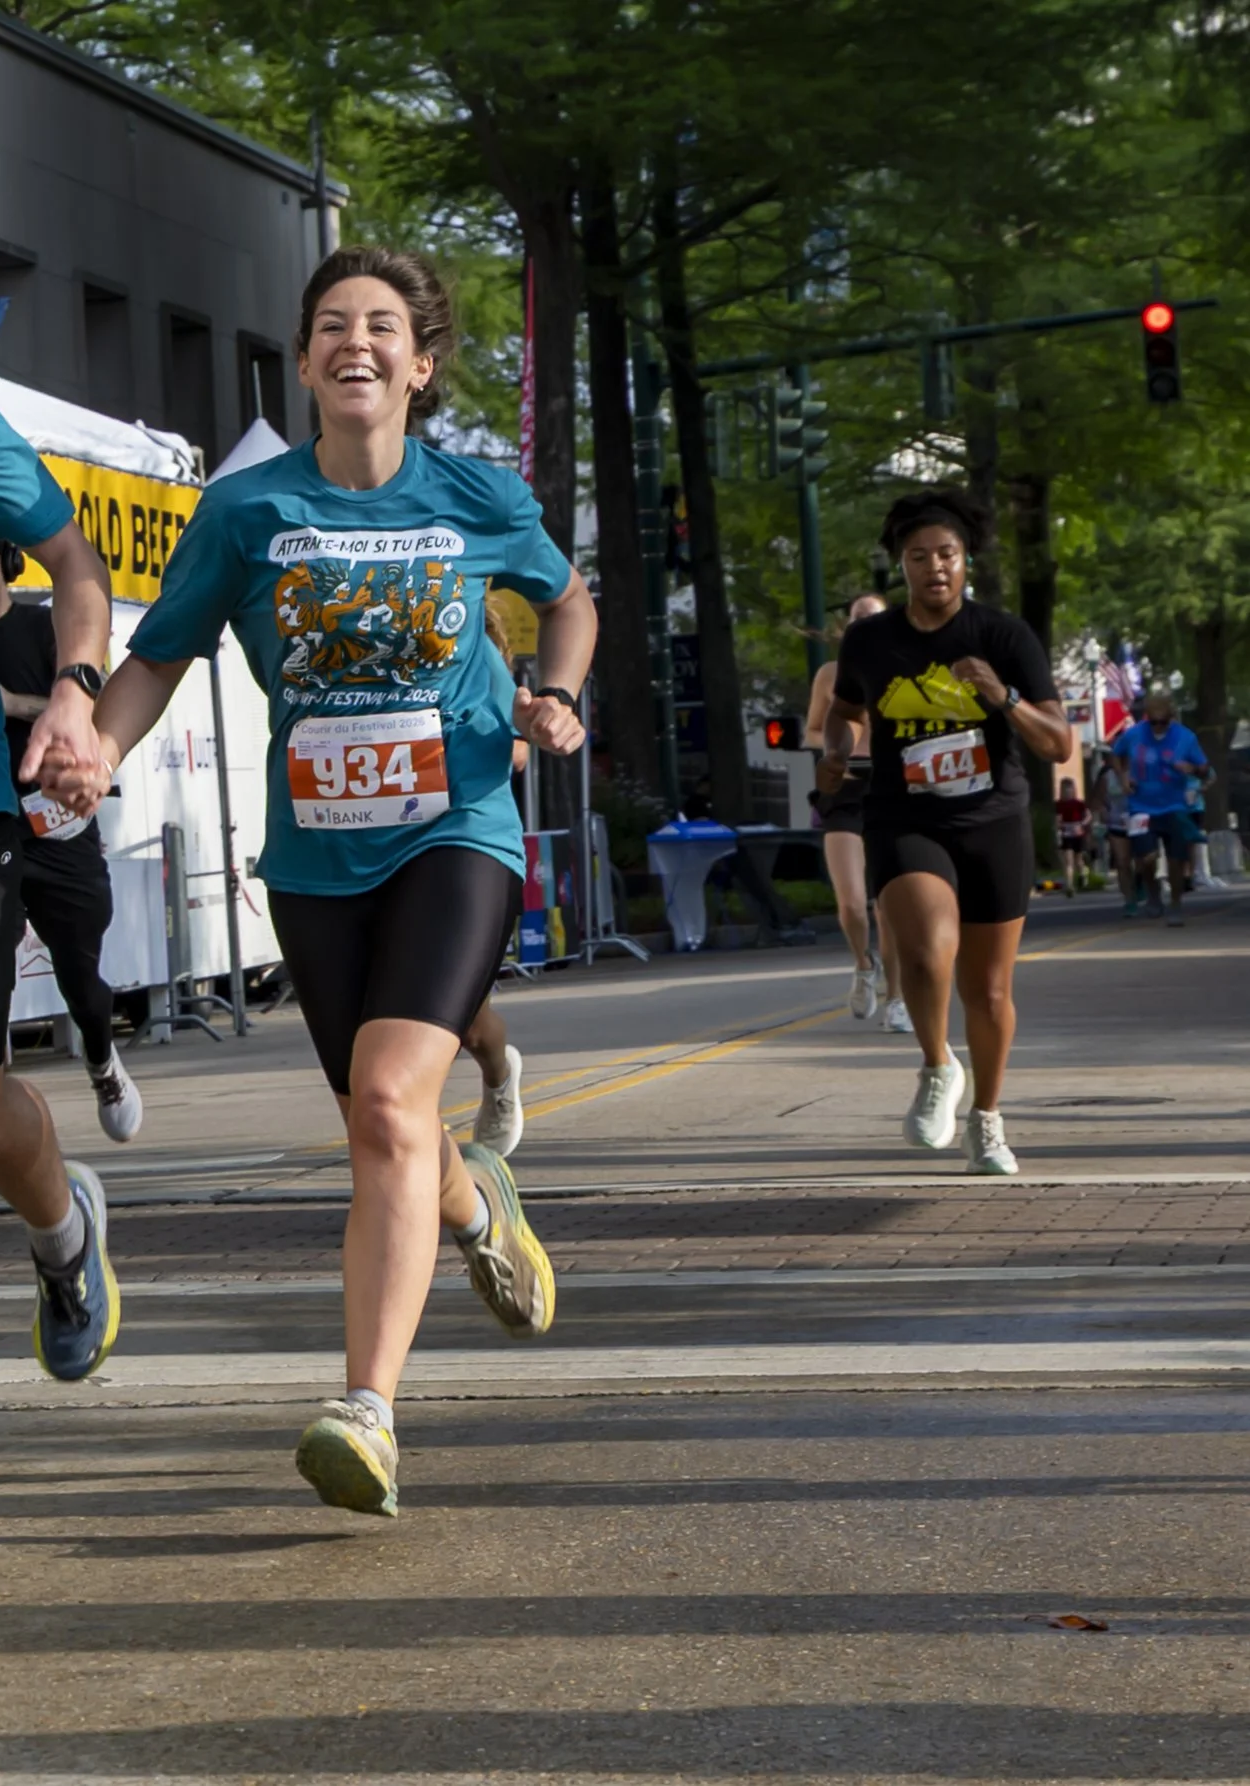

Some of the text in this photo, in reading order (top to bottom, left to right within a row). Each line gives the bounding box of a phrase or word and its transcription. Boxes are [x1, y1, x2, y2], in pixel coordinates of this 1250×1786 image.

[65, 488, 123, 571] OLD
[374, 540, 386, 553] SI
[392, 539, 412, 551] TU
[416, 536, 456, 551] PEUX!
[403, 688, 440, 703] 2026
[301, 716, 425, 735] Courir du Festival 2026
[312, 744, 418, 798] 934
[919, 749, 976, 783] 144
